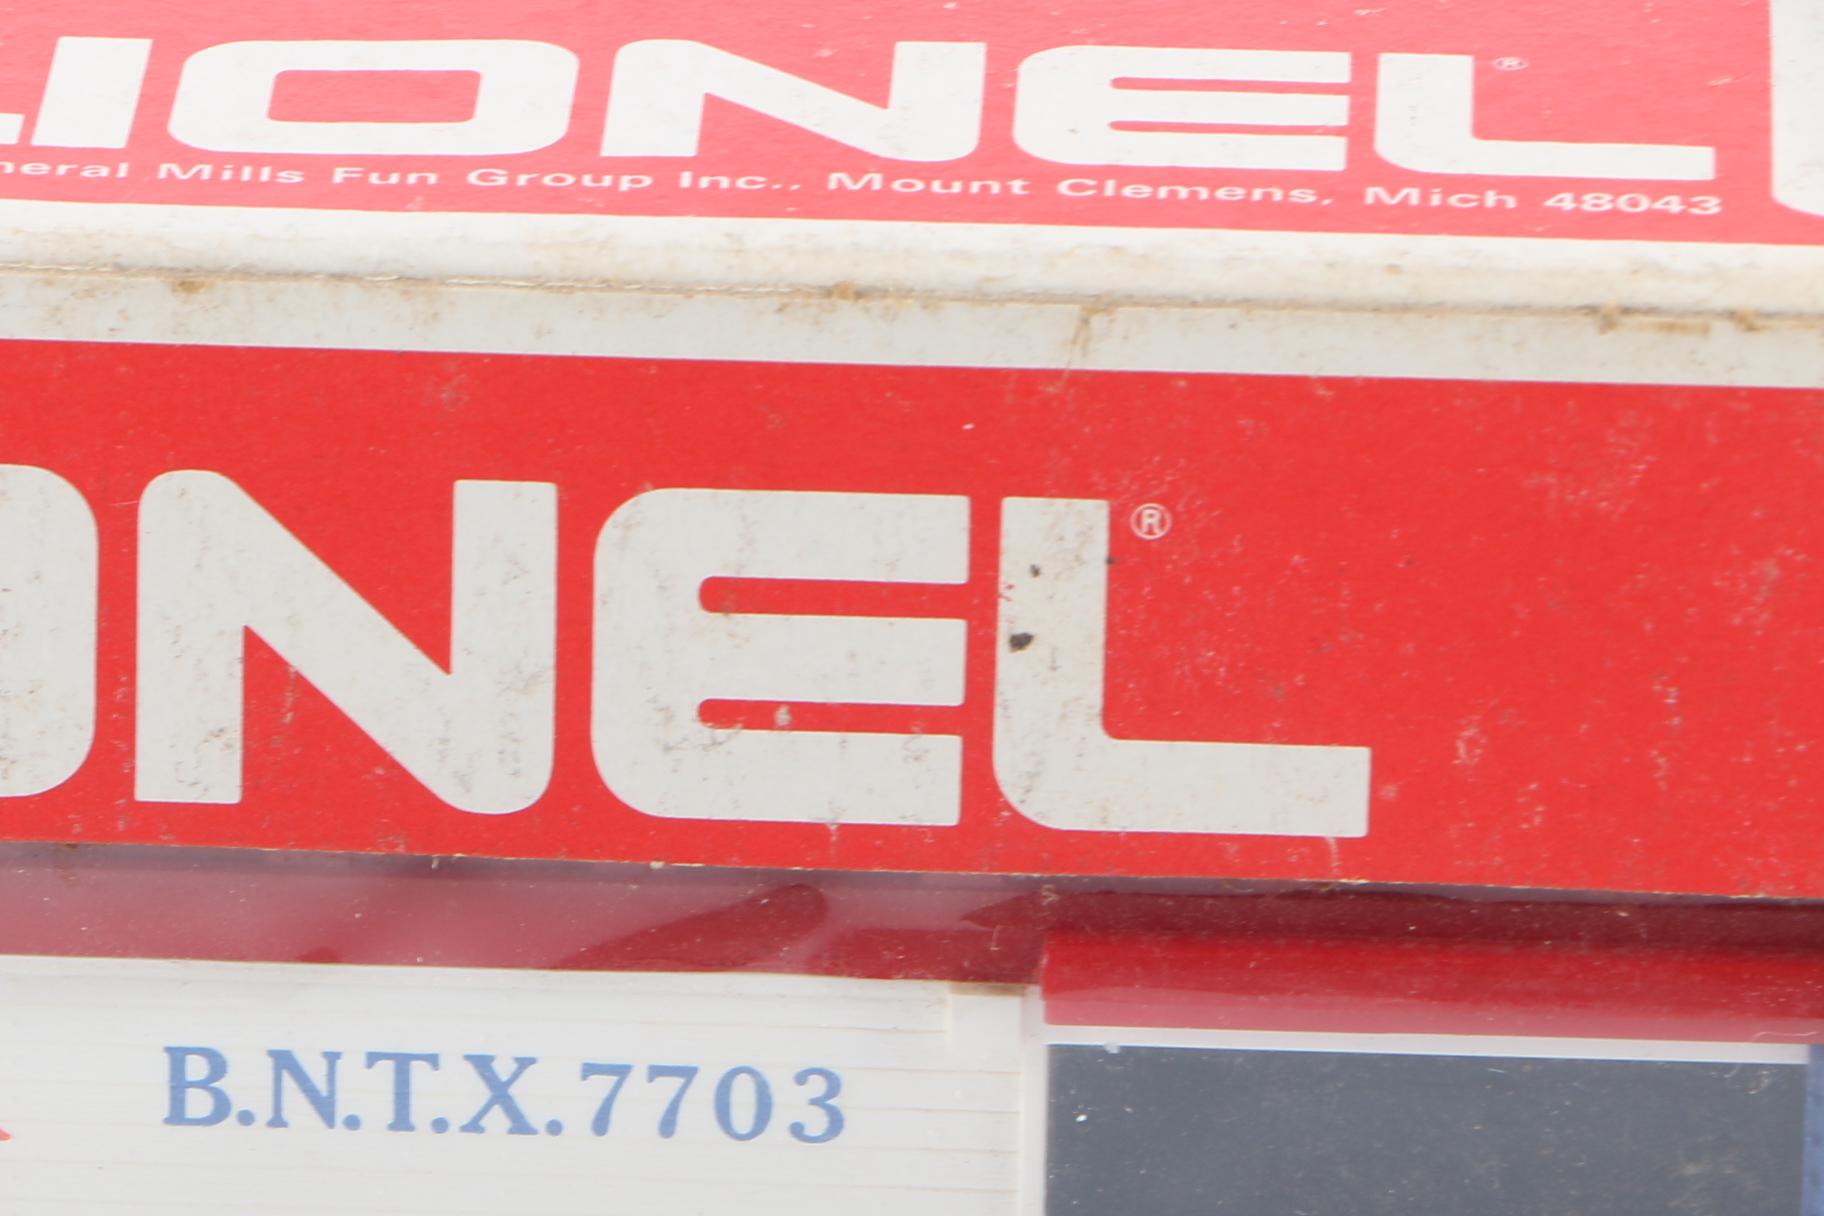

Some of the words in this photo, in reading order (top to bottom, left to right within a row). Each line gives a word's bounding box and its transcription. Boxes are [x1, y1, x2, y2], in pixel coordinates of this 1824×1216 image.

[157, 161, 306, 184] Mills
[331, 166, 439, 187] Fun
[466, 168, 654, 192] Group
[827, 172, 1031, 196] Mount
[1057, 178, 1335, 207] Clemens,
[1364, 186, 1518, 210] Mich
[1542, 191, 1724, 216] 48043
